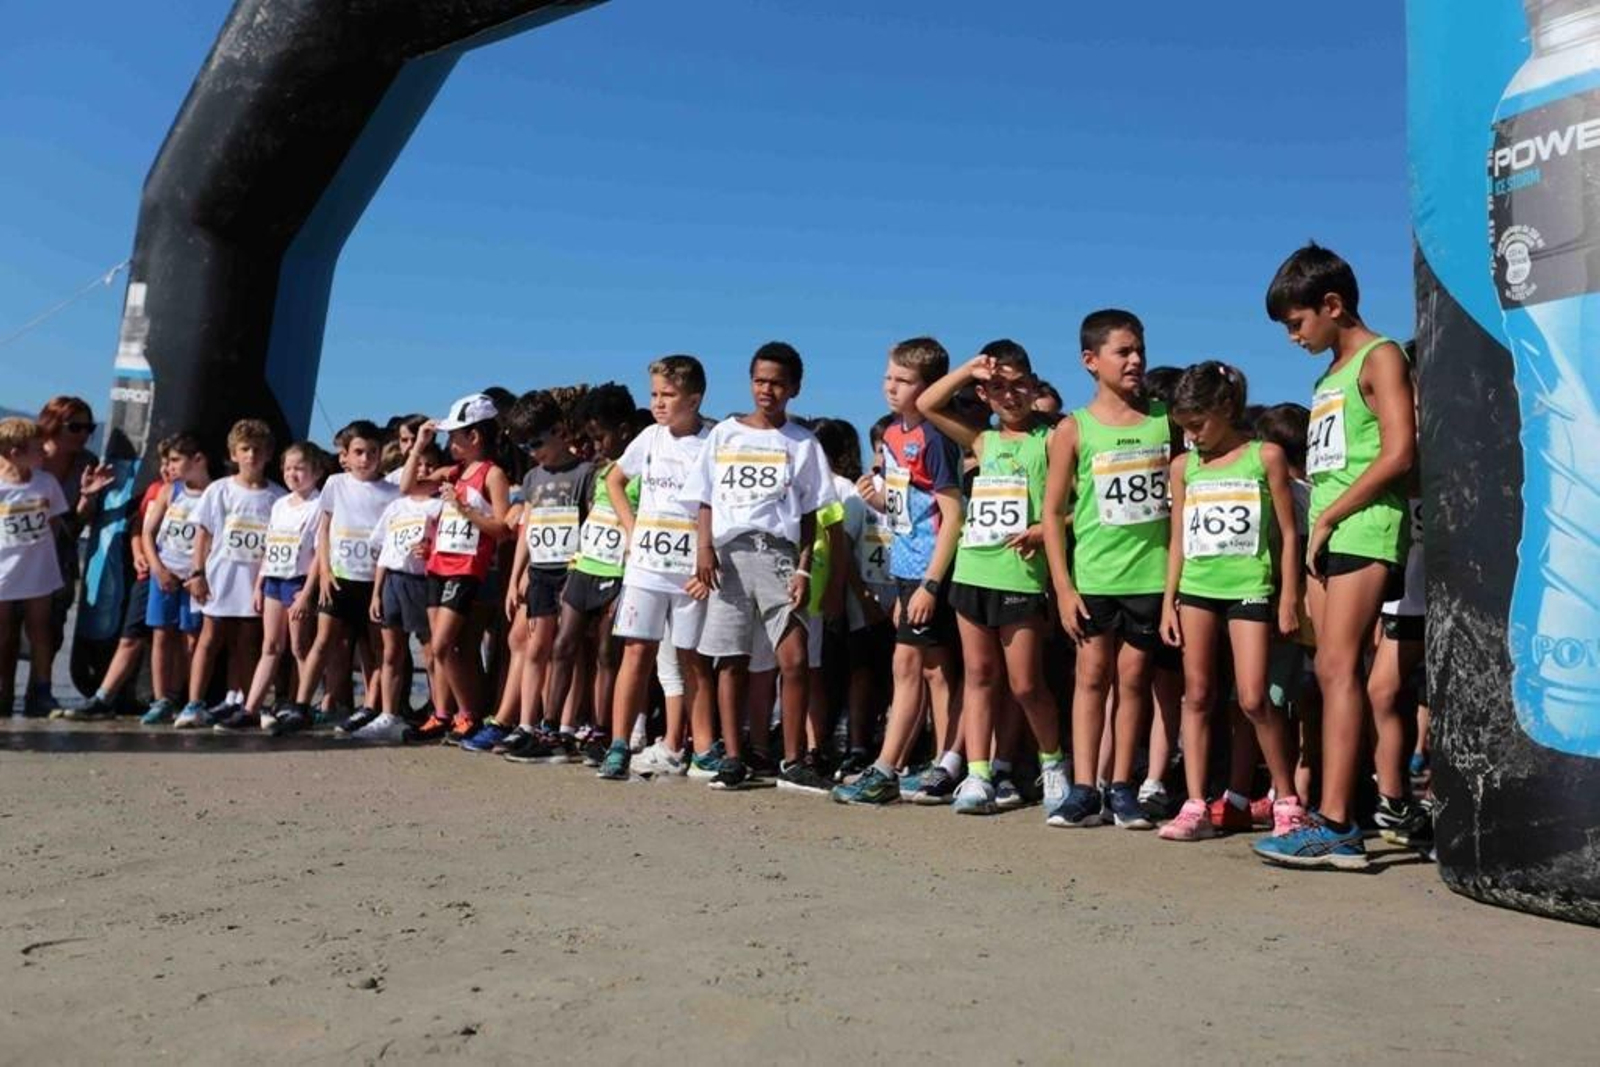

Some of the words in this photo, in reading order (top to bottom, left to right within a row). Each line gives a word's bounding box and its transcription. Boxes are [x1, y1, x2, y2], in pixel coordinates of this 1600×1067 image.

[1494, 119, 1600, 178] POWE
[721, 465, 777, 489] 488
[1105, 471, 1166, 505] 485
[4, 511, 46, 535] 512
[1190, 505, 1251, 535] 463
[530, 526, 573, 548] 507
[639, 530, 691, 557] 464
